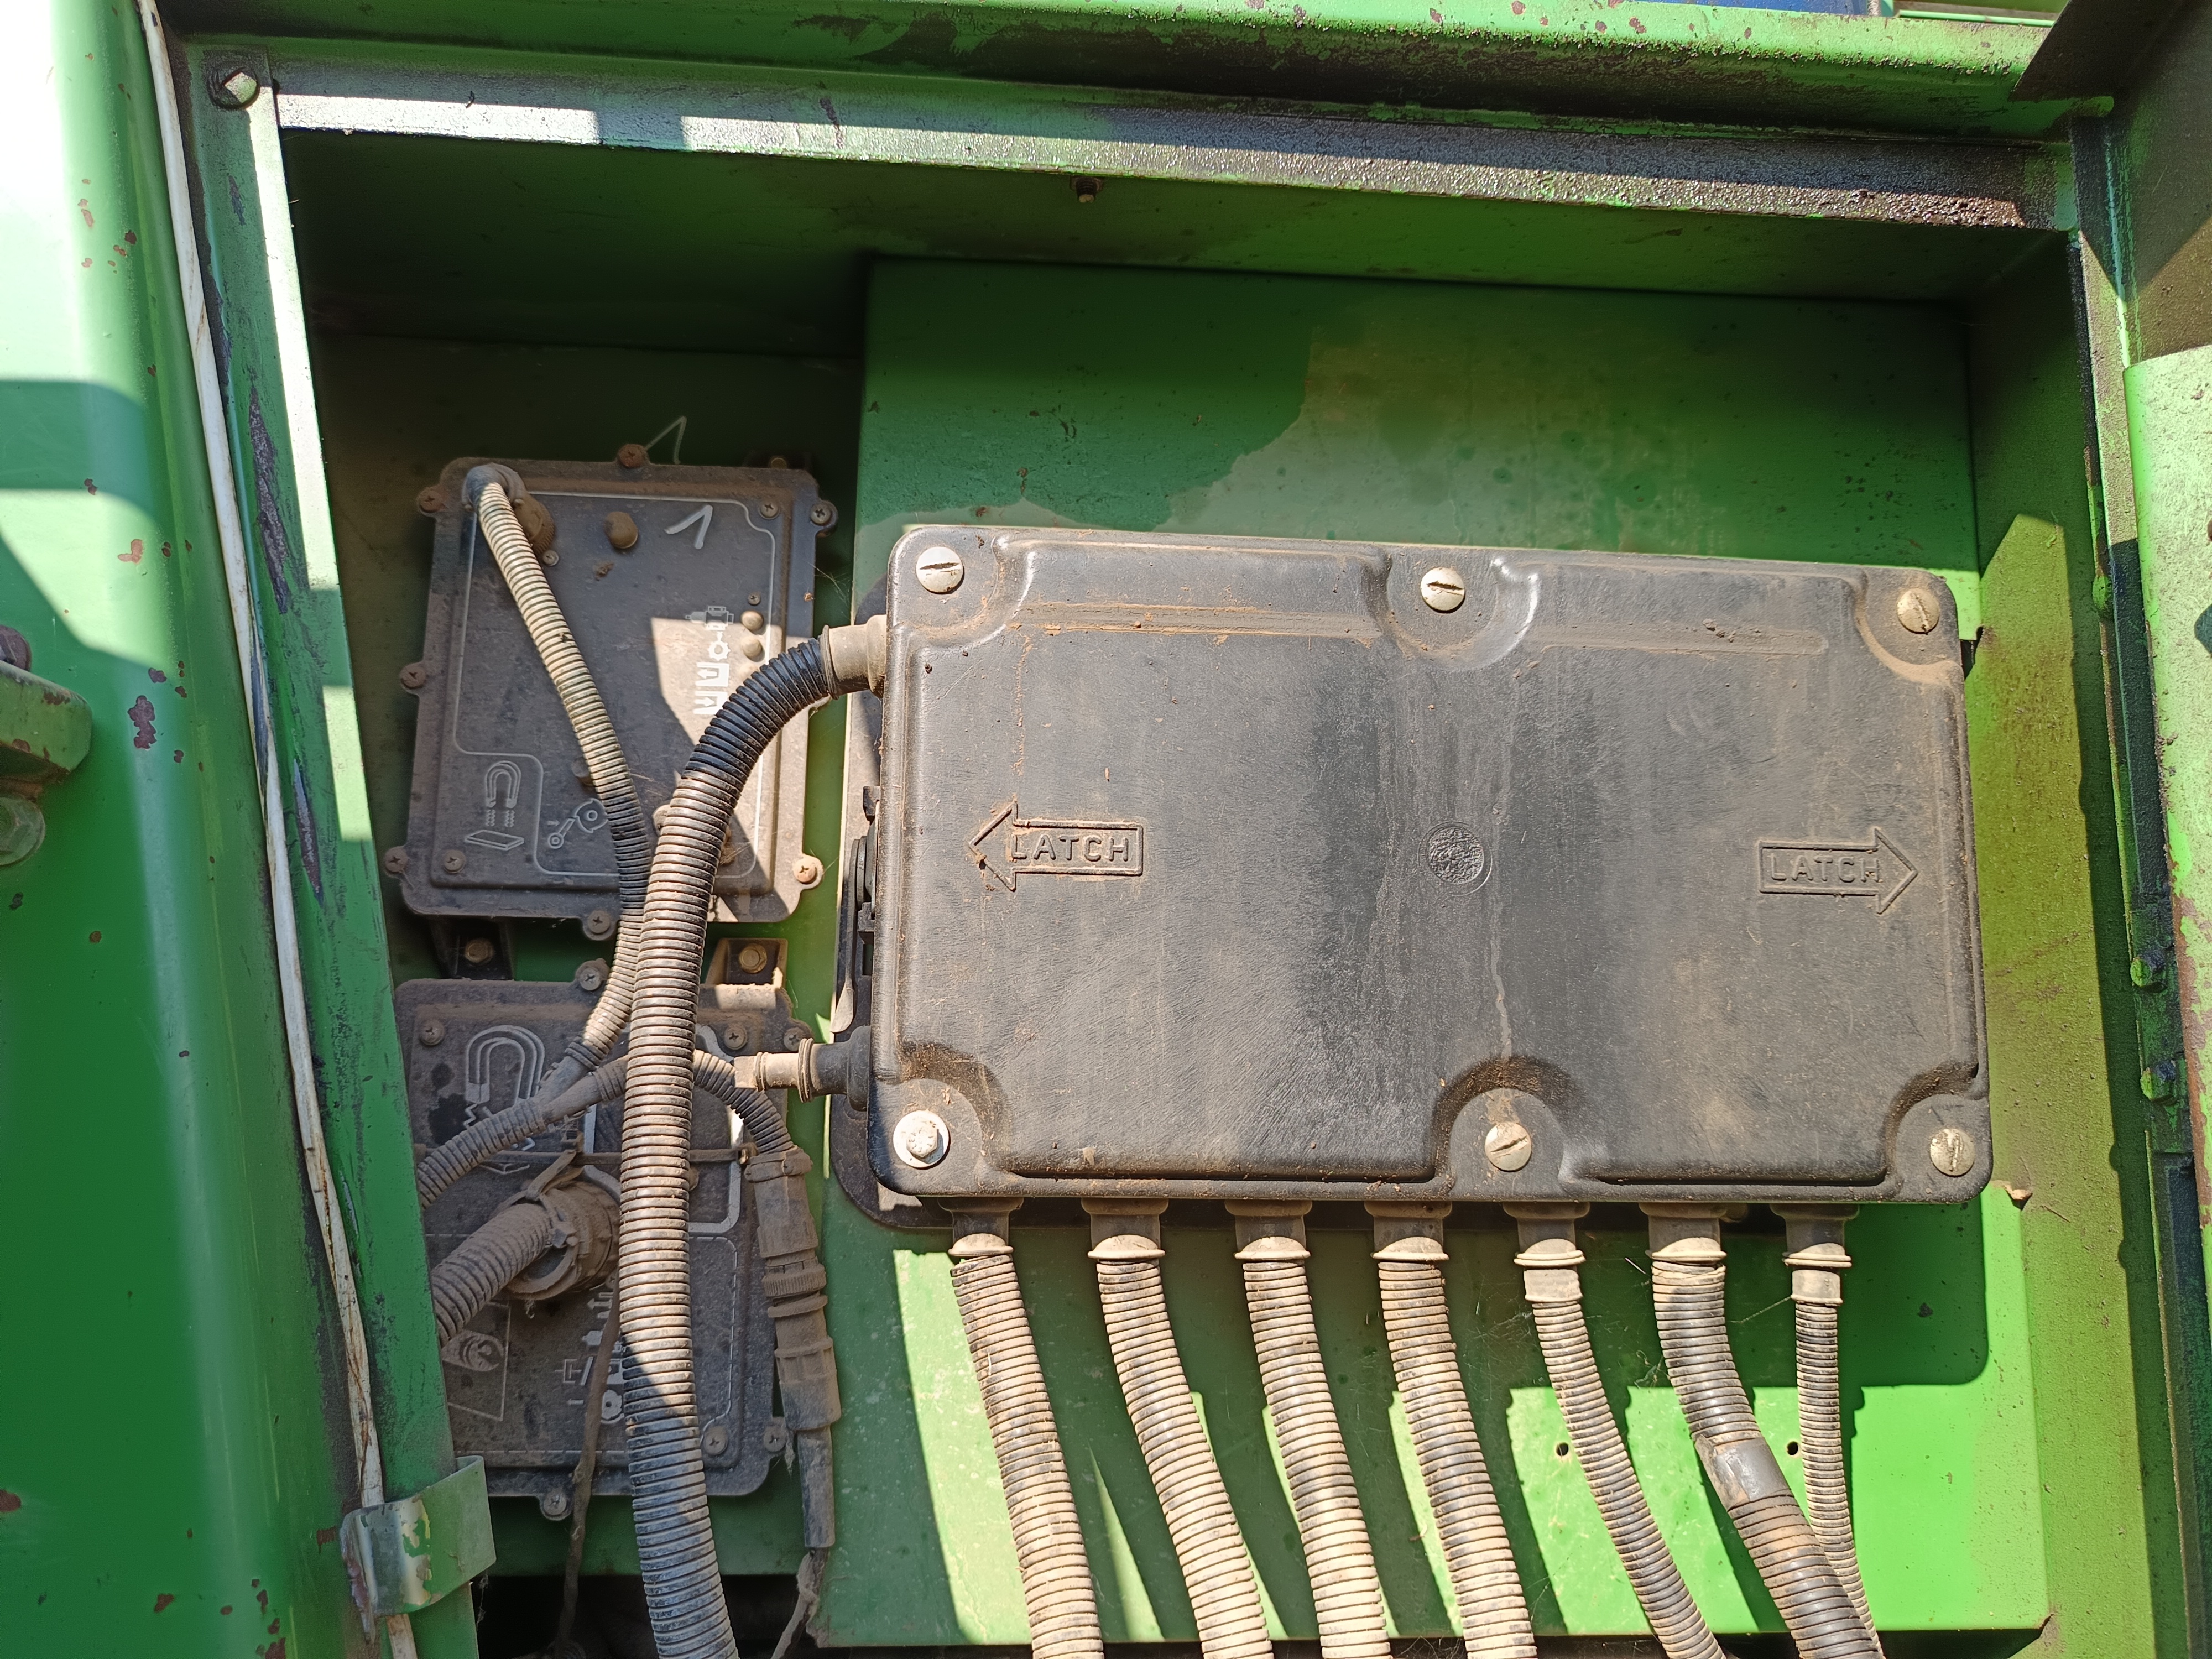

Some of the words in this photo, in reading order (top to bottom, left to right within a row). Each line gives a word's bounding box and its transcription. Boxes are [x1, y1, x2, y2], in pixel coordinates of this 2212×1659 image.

[664, 504, 713, 549] 1
[1011, 834, 1129, 862] LATCH
[1770, 853, 1882, 883] LATCH
